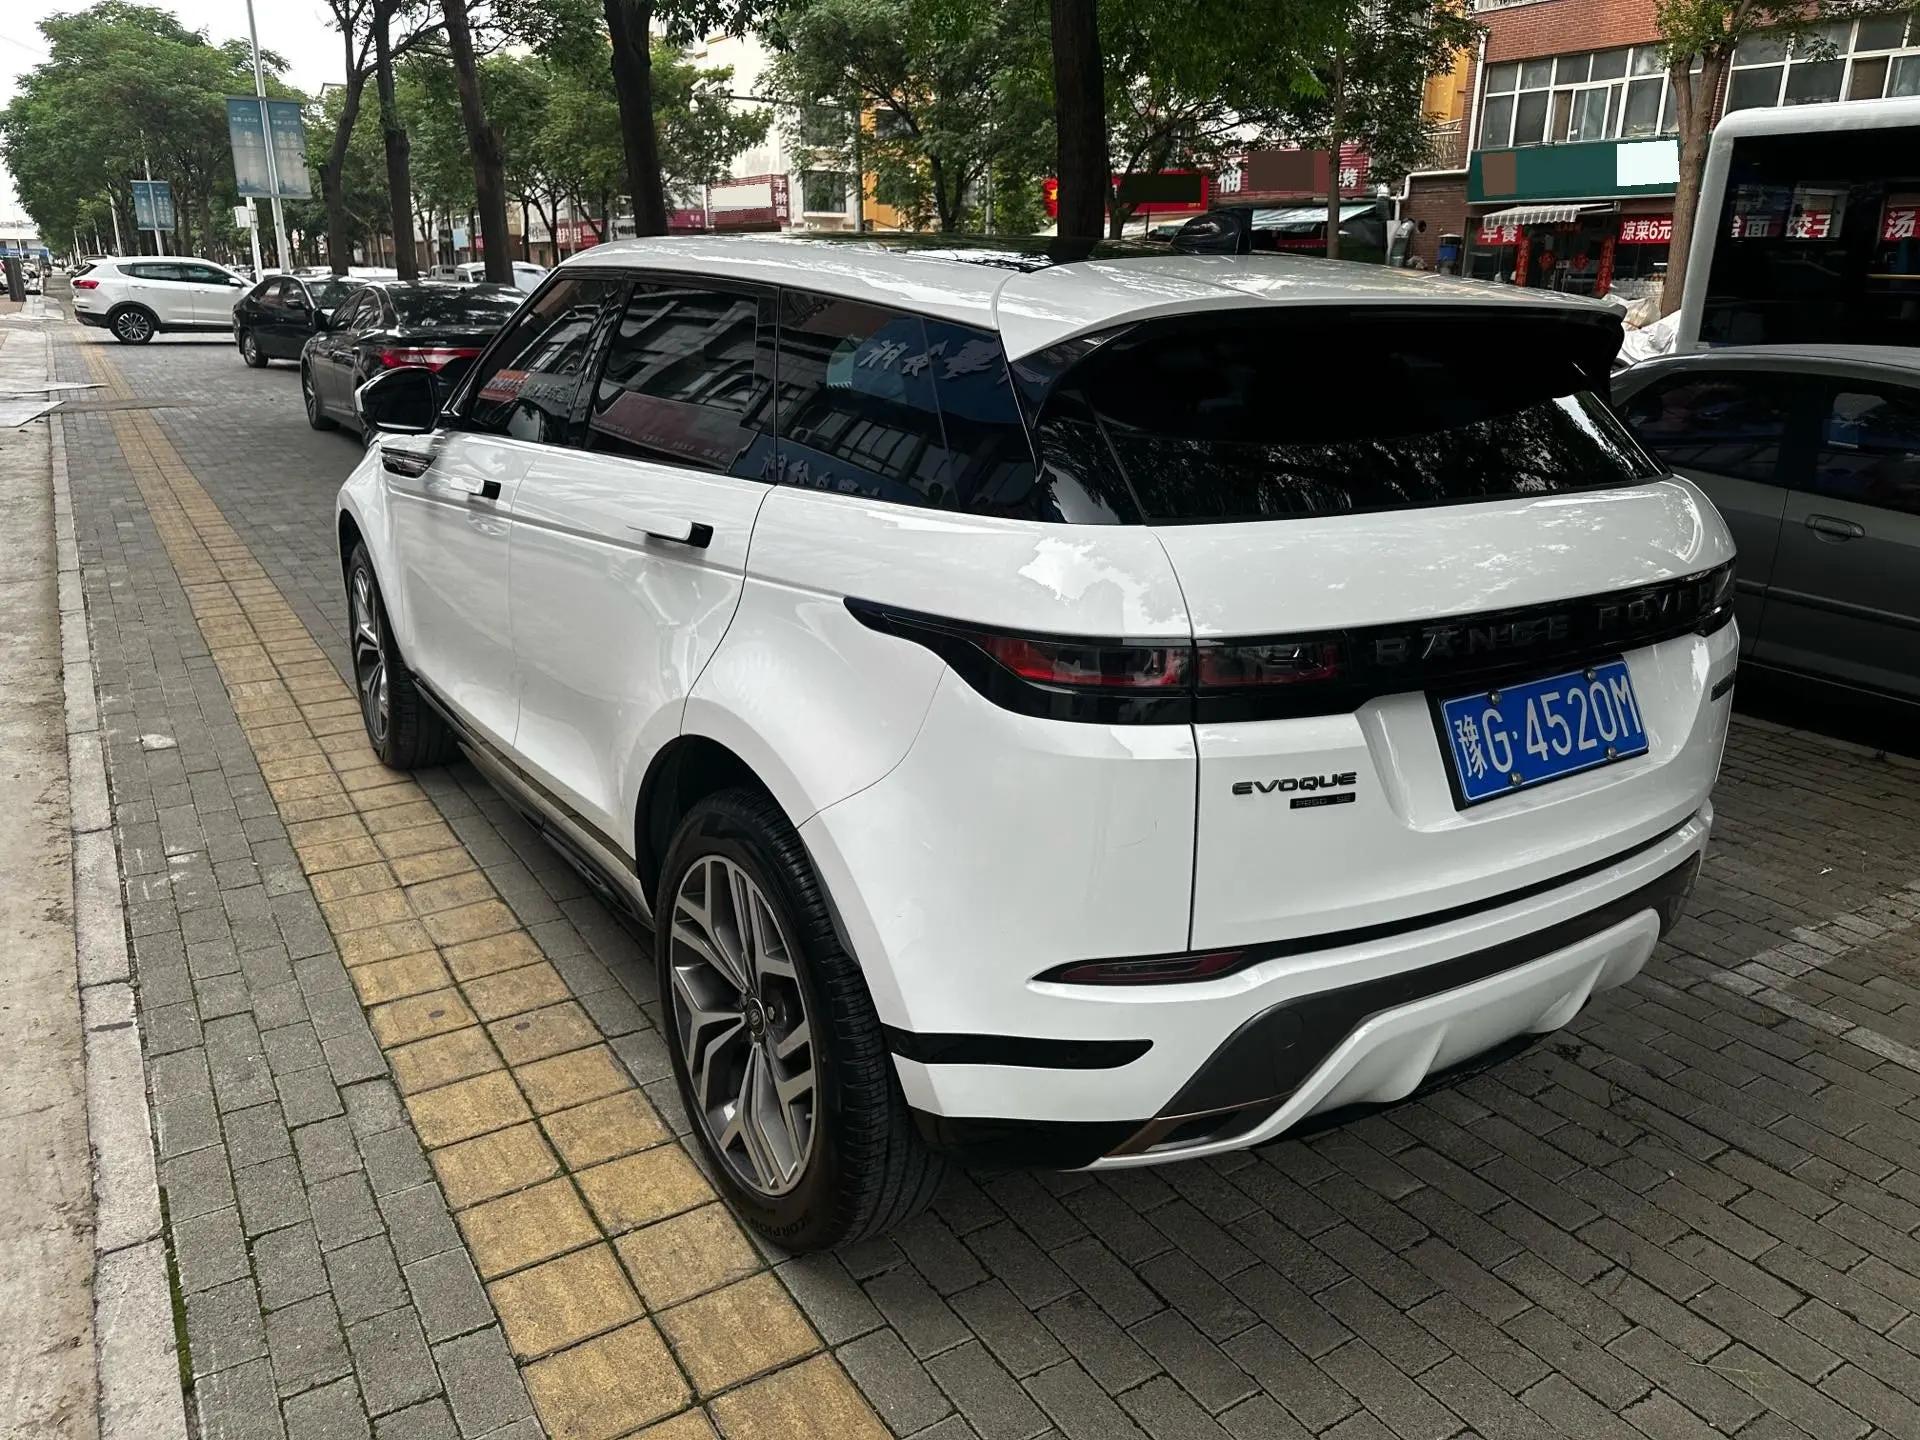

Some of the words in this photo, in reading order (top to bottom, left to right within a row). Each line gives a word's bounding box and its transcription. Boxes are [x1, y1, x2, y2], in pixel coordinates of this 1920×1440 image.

[1481, 224, 1518, 243] 早餐
[1621, 220, 1672, 240] 凉菜6元
[1785, 213, 1831, 239] 饺子
[1884, 210, 1916, 238] 汤
[1232, 772, 1357, 795] EVOQUE
